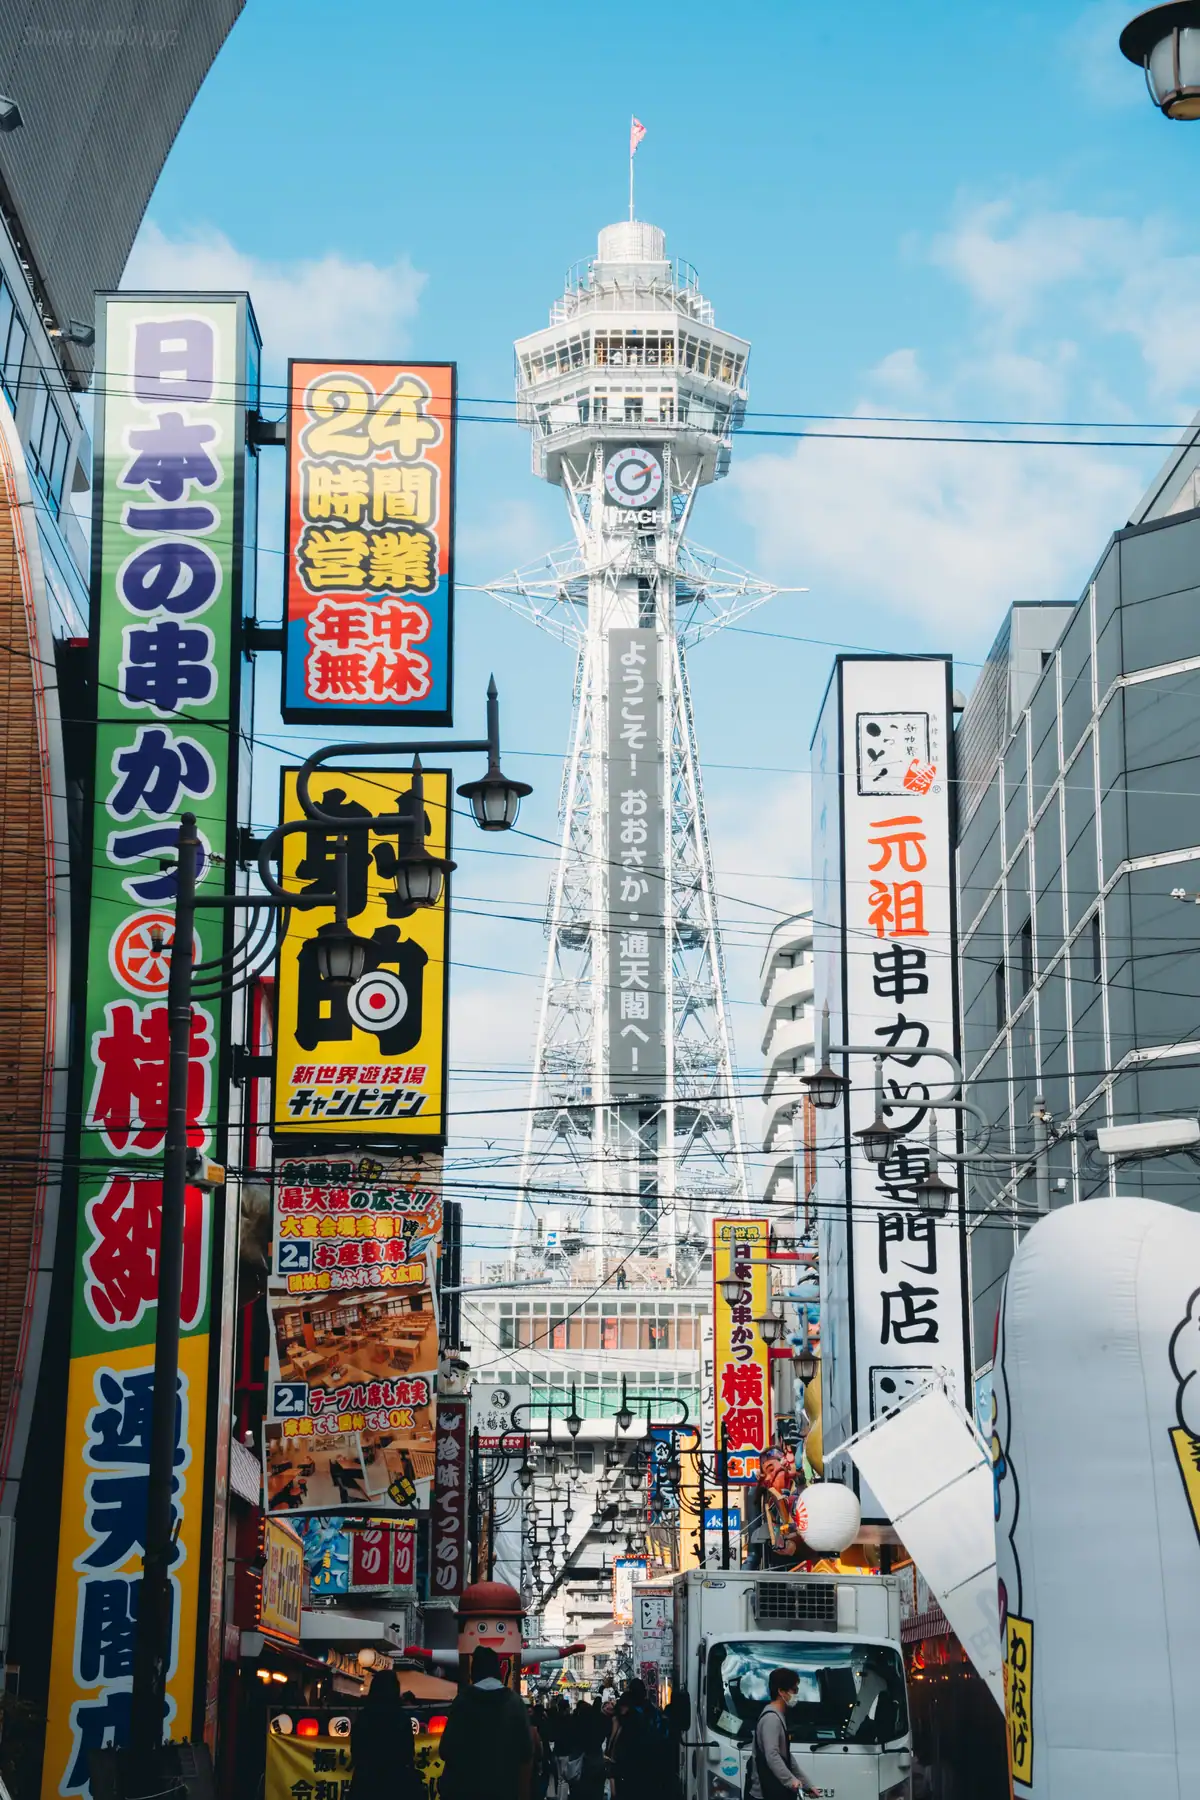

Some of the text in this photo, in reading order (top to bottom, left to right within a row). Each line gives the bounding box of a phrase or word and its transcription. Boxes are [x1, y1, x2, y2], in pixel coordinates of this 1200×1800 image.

[302, 460, 440, 528] 時間
[296, 526, 439, 594] 営業
[113, 317, 222, 905] 日本一の串かつ
[306, 599, 431, 652] 年中
[305, 650, 432, 703] 無休
[291, 1065, 428, 1085] 新世界遊技場
[287, 1087, 428, 1117] チャンピオン
[314, 1239, 407, 1270] お座敷席
[731, 1243, 754, 1361] 日本の串かつ
[309, 1379, 429, 1414] テーブル席も充実
[721, 1363, 764, 1452] 横綱
[706, 1514, 738, 1528] Ashi
